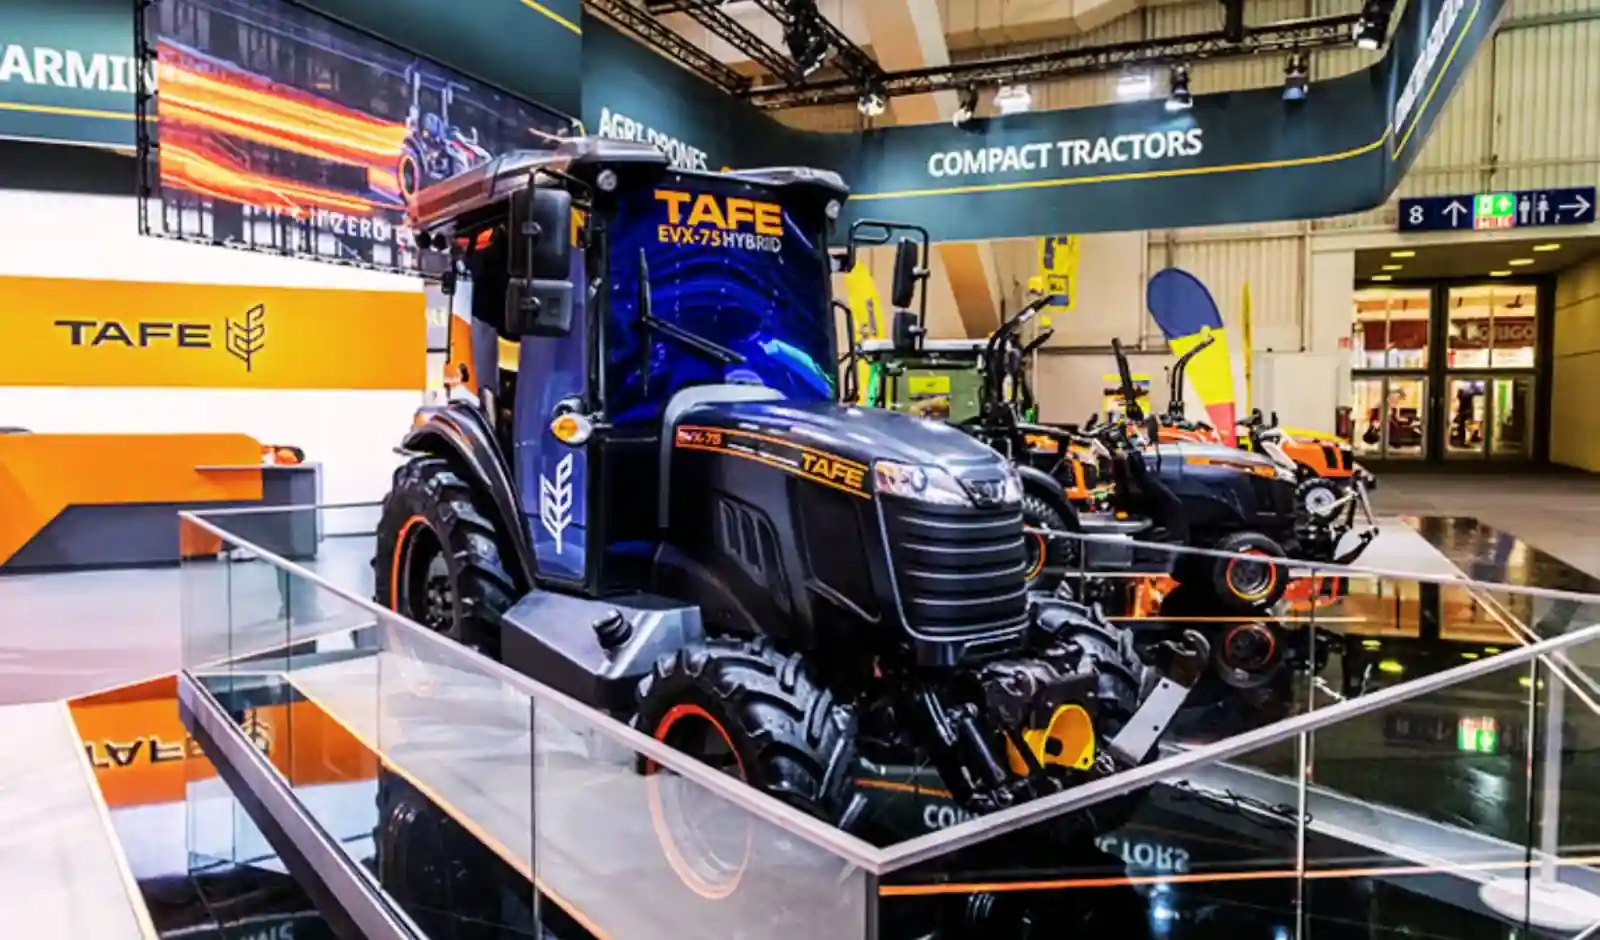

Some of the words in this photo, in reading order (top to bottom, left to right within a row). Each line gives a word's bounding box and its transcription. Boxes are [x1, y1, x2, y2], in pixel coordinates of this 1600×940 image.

[928, 143, 1053, 178] COMPACT
[1057, 127, 1203, 166] TRACTORS
[653, 188, 784, 236] TAFE
[1409, 205, 1424, 225] 8
[658, 224, 721, 247] EVX-75
[722, 230, 782, 253] HYBRID
[54, 319, 212, 348] TAFE
[802, 452, 865, 489] TAFE
